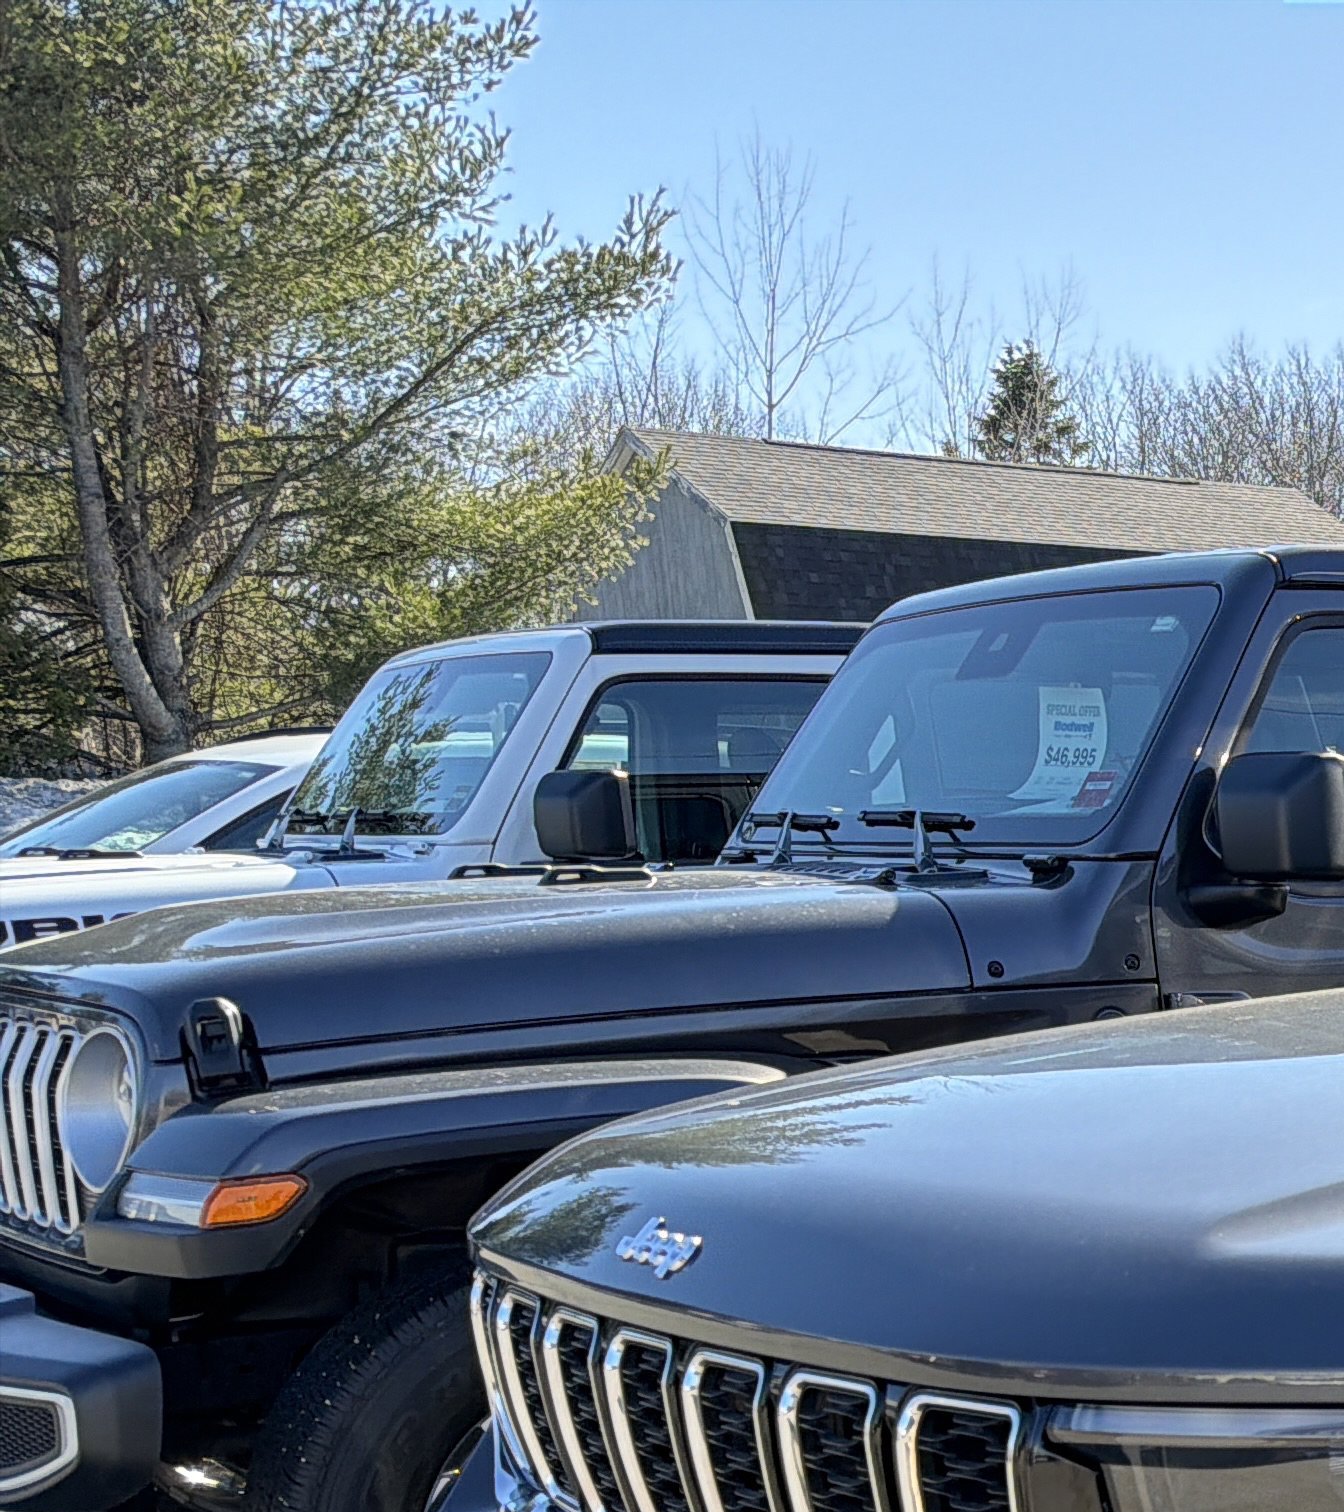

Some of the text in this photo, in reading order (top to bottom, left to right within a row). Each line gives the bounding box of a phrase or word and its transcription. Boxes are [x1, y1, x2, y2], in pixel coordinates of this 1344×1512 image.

[1046, 704, 1078, 716] SPECIAL
[1053, 720, 1094, 733] Bodwell
[1044, 744, 1097, 768] $46,995
[615, 1216, 703, 1280] Jeep
